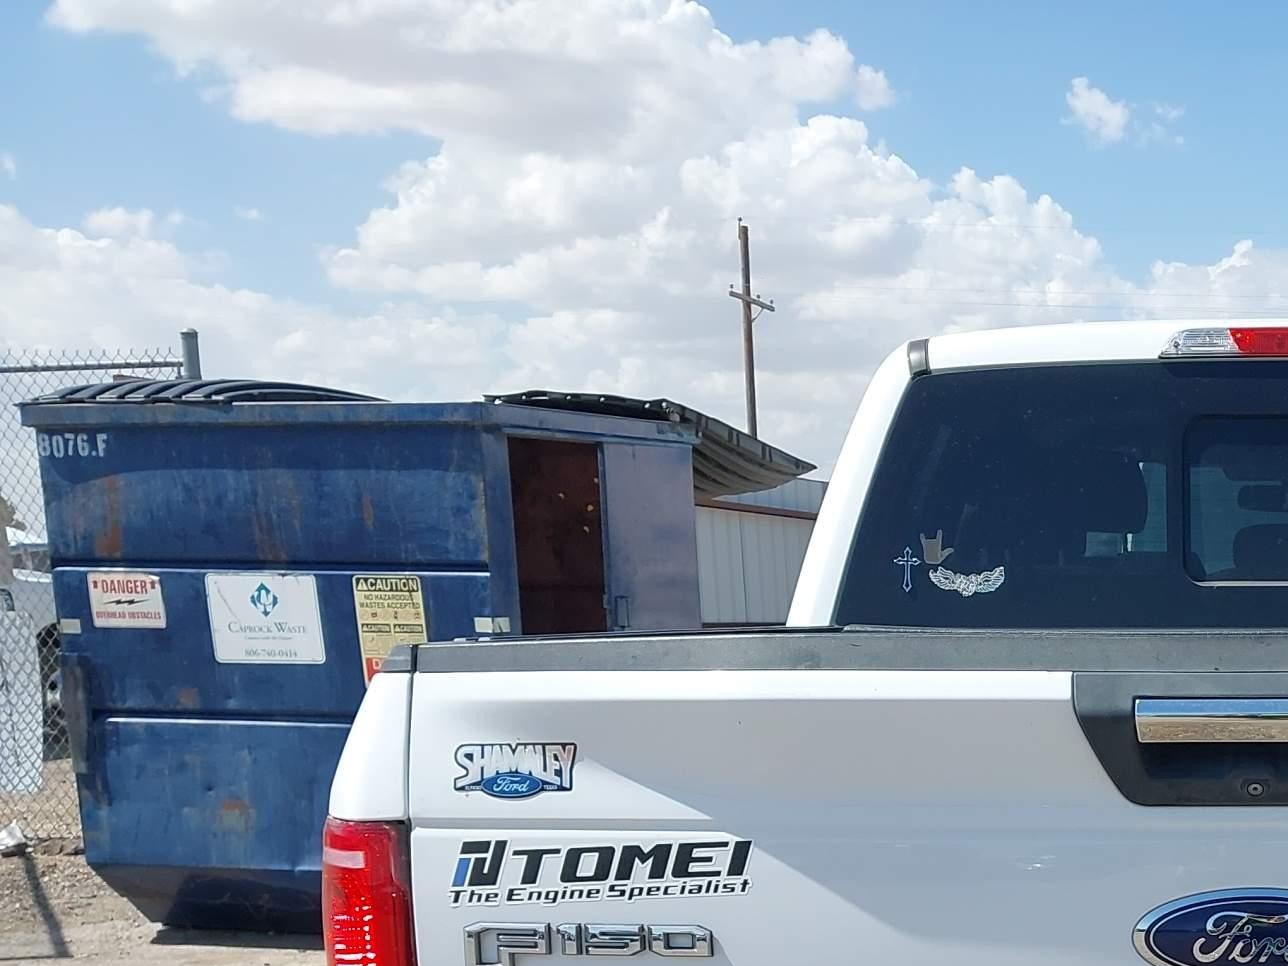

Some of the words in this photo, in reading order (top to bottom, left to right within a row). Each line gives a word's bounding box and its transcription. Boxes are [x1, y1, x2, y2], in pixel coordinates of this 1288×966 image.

[38, 432, 108, 458] 8076.F
[101, 579, 148, 595] DANGER
[367, 578, 418, 591] CAUTION
[359, 601, 386, 609] WASTES
[387, 601, 421, 609] ACCEPTED
[364, 593, 374, 601] NO
[228, 621, 273, 634] CAPROCK
[274, 622, 307, 634] WASTE
[492, 776, 531, 792] Ford
[511, 840, 753, 886] TOMEI
[450, 890, 499, 904] The
[506, 886, 601, 905] Engine
[605, 879, 751, 900] Specialist
